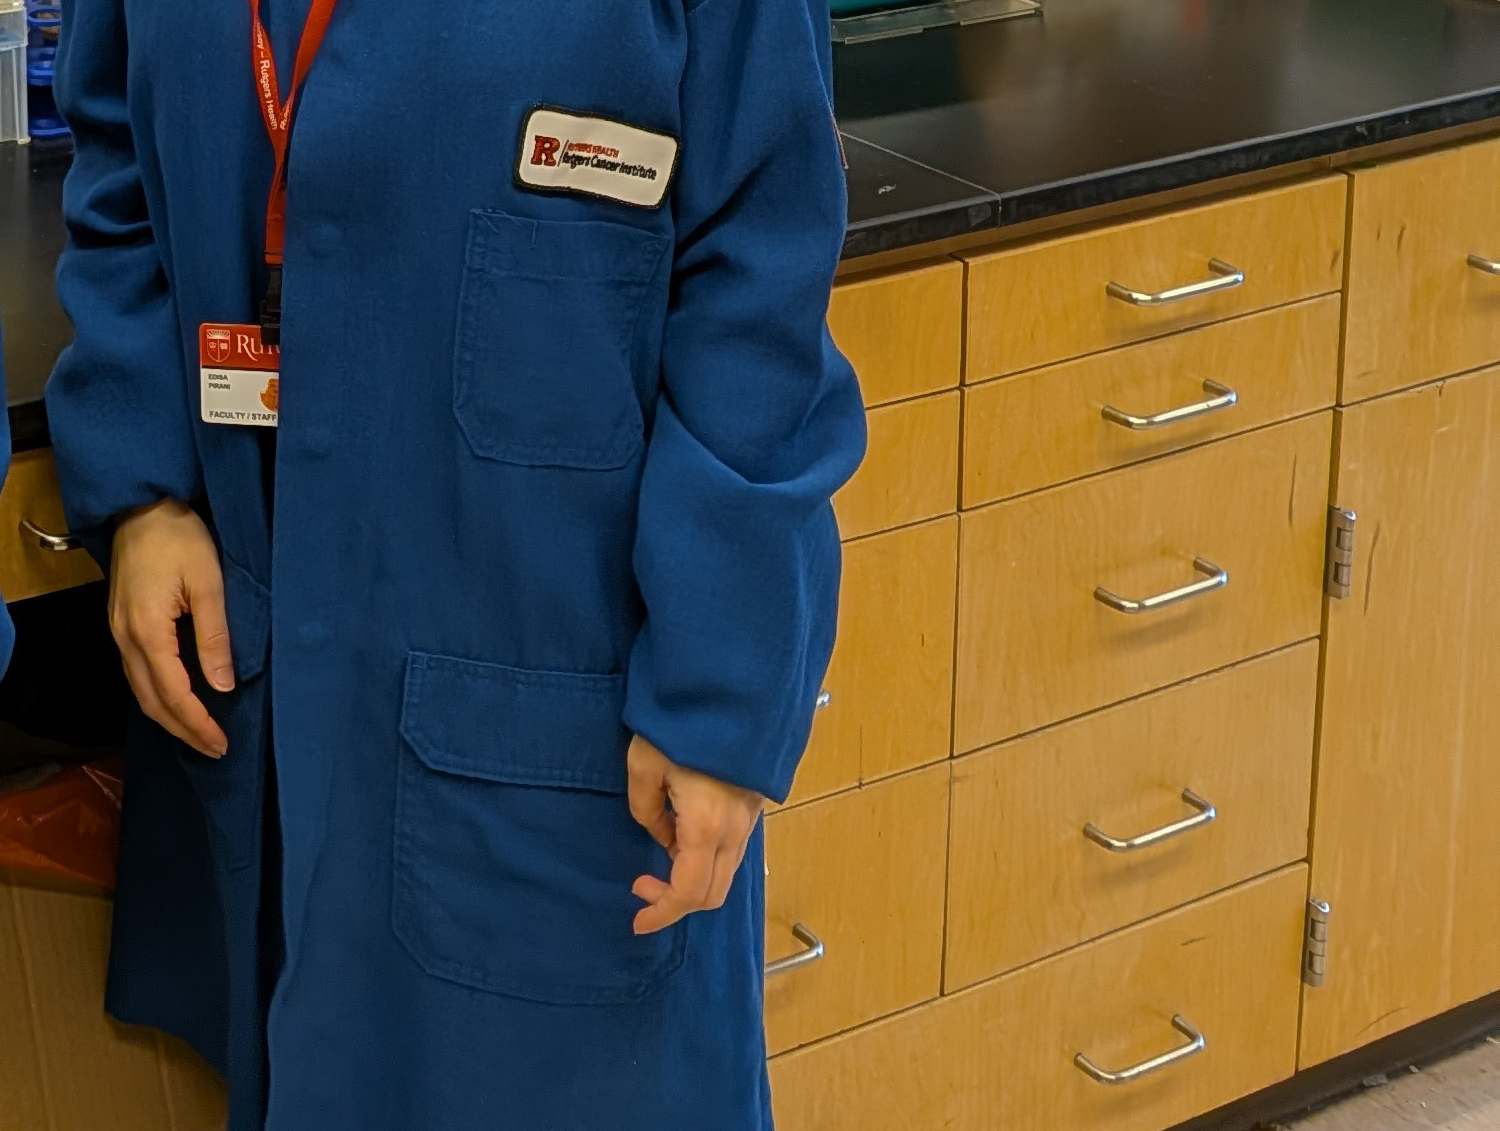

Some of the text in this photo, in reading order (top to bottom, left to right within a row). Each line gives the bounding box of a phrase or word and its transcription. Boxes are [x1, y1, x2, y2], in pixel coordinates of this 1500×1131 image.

[530, 134, 560, 167] R
[591, 154, 620, 172] Cancer
[619, 160, 657, 181] Institute
[209, 411, 246, 420] FACULTY
